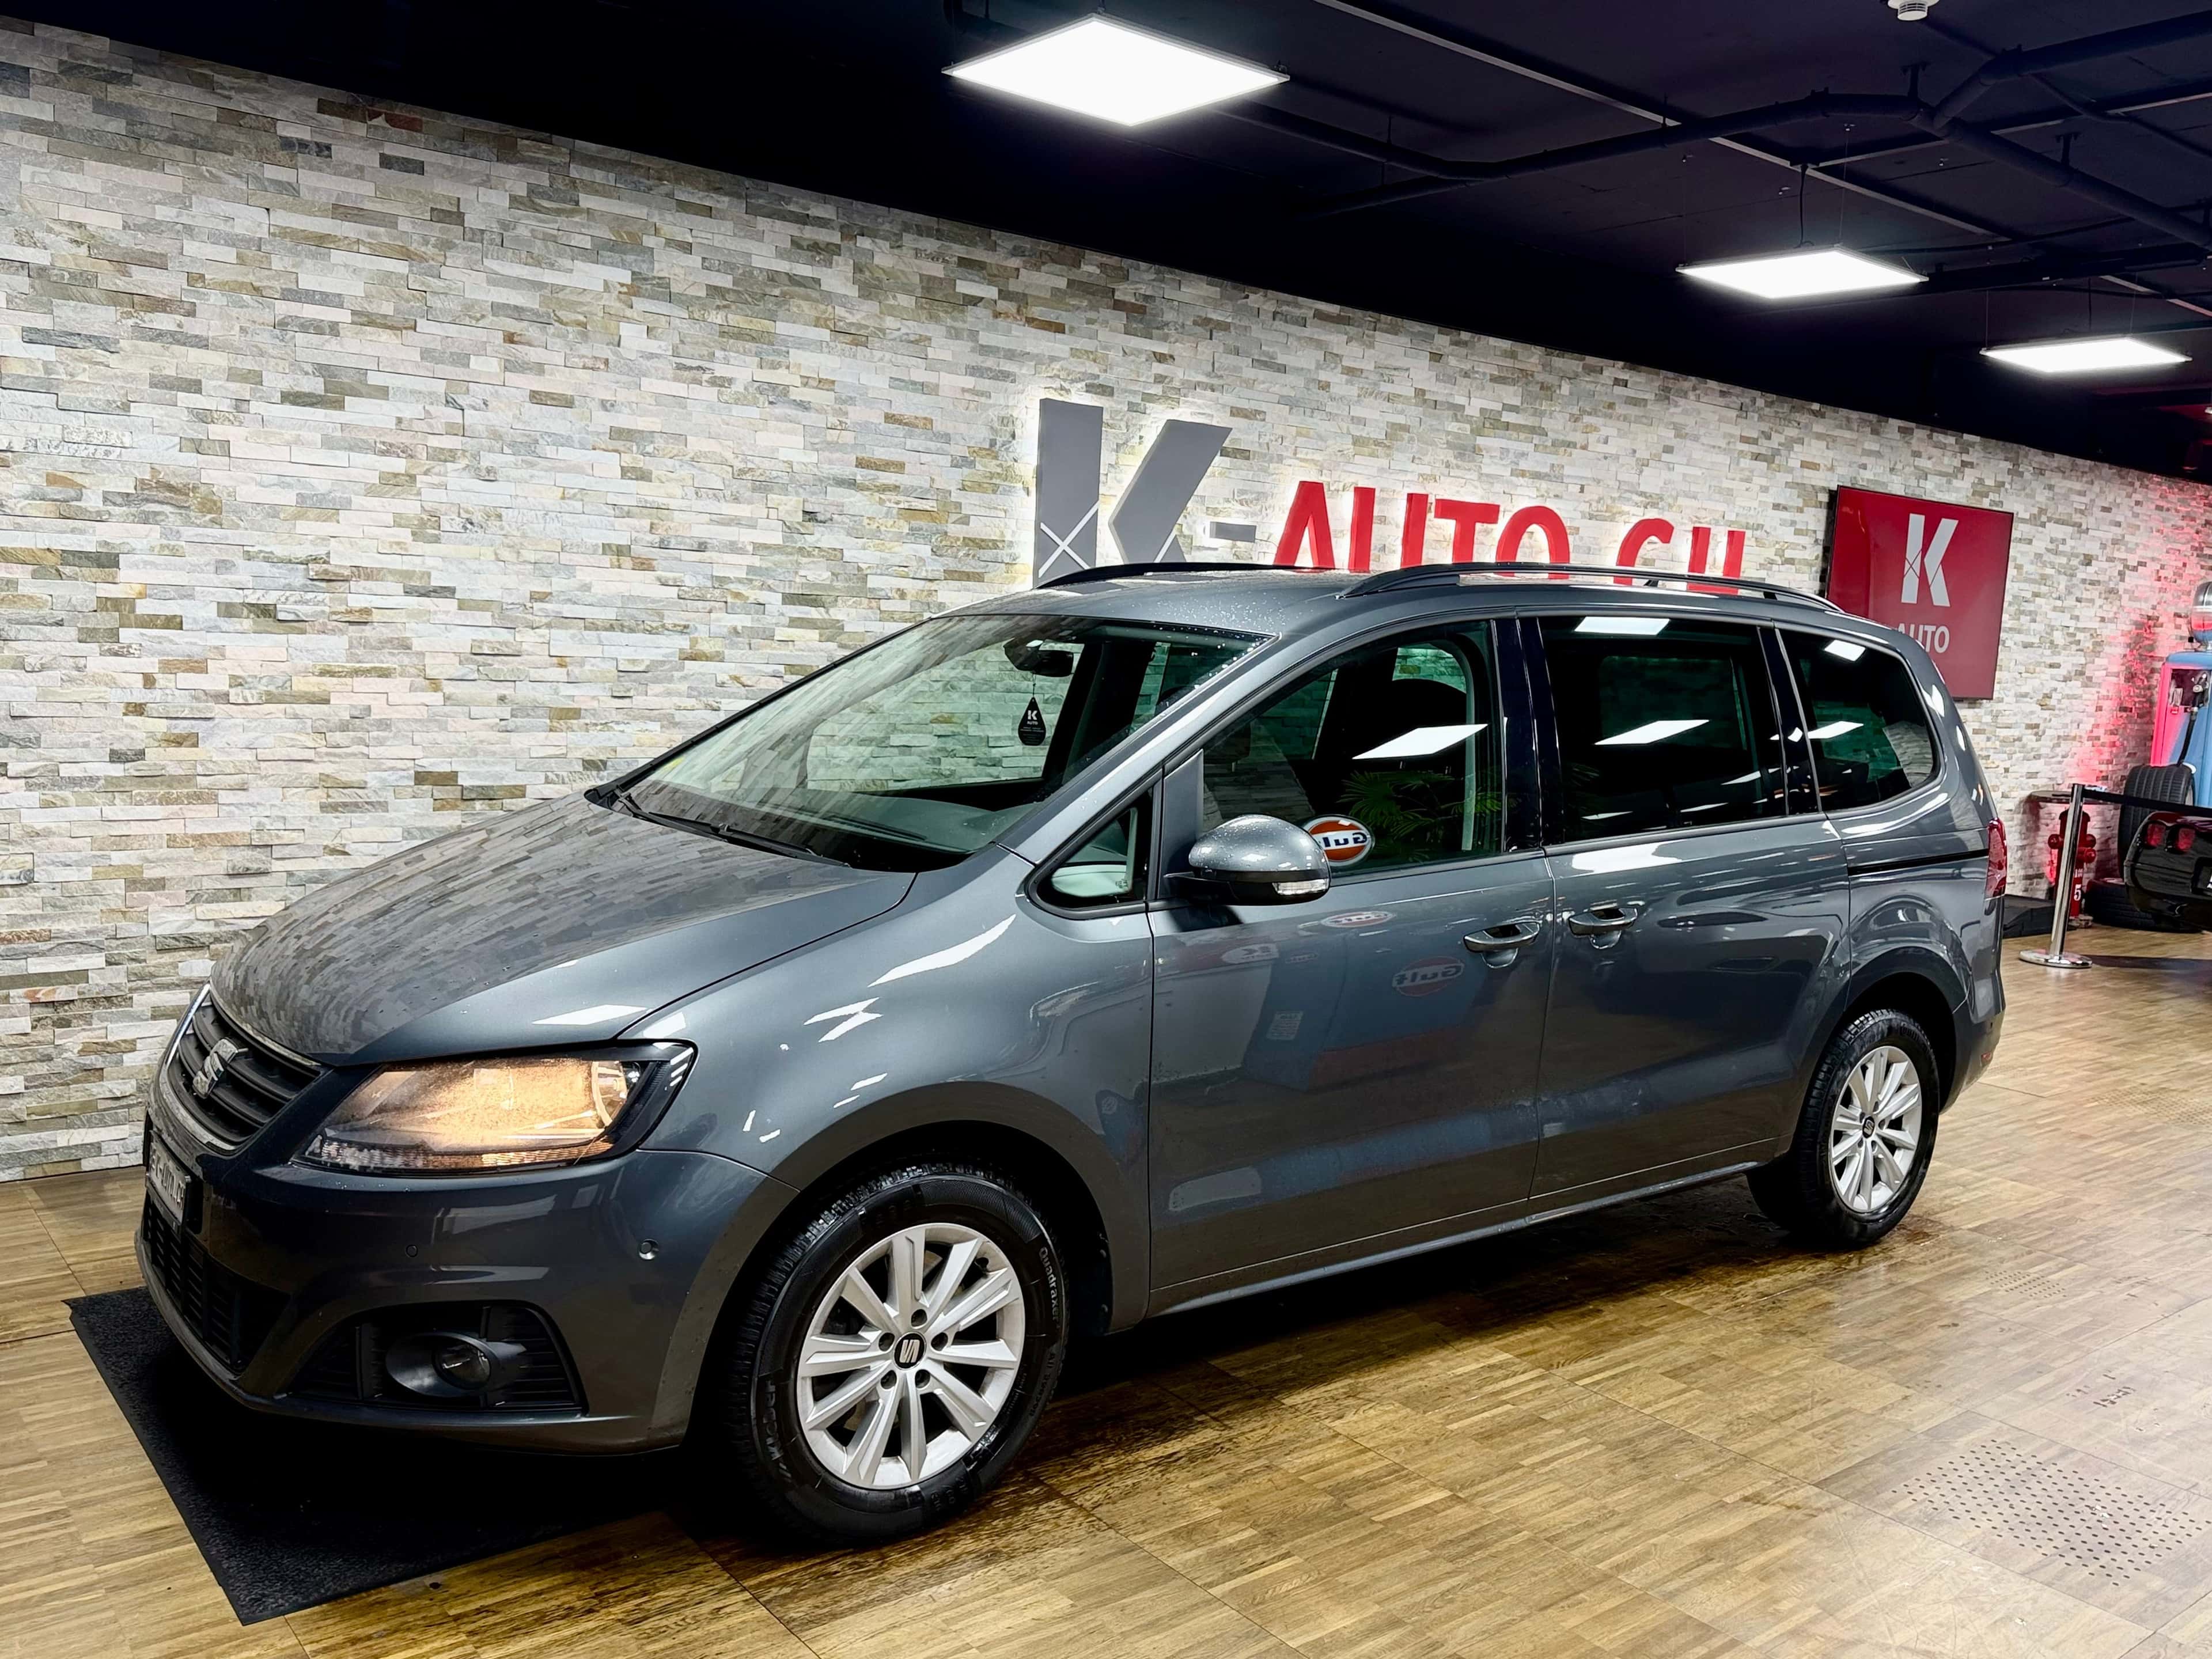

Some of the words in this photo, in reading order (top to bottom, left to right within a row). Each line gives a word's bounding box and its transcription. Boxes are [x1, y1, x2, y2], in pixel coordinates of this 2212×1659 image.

[1901, 513, 1959, 607] K
[1028, 710, 1037, 720] K
[1039, 1247, 1059, 1322] Quadraxer
